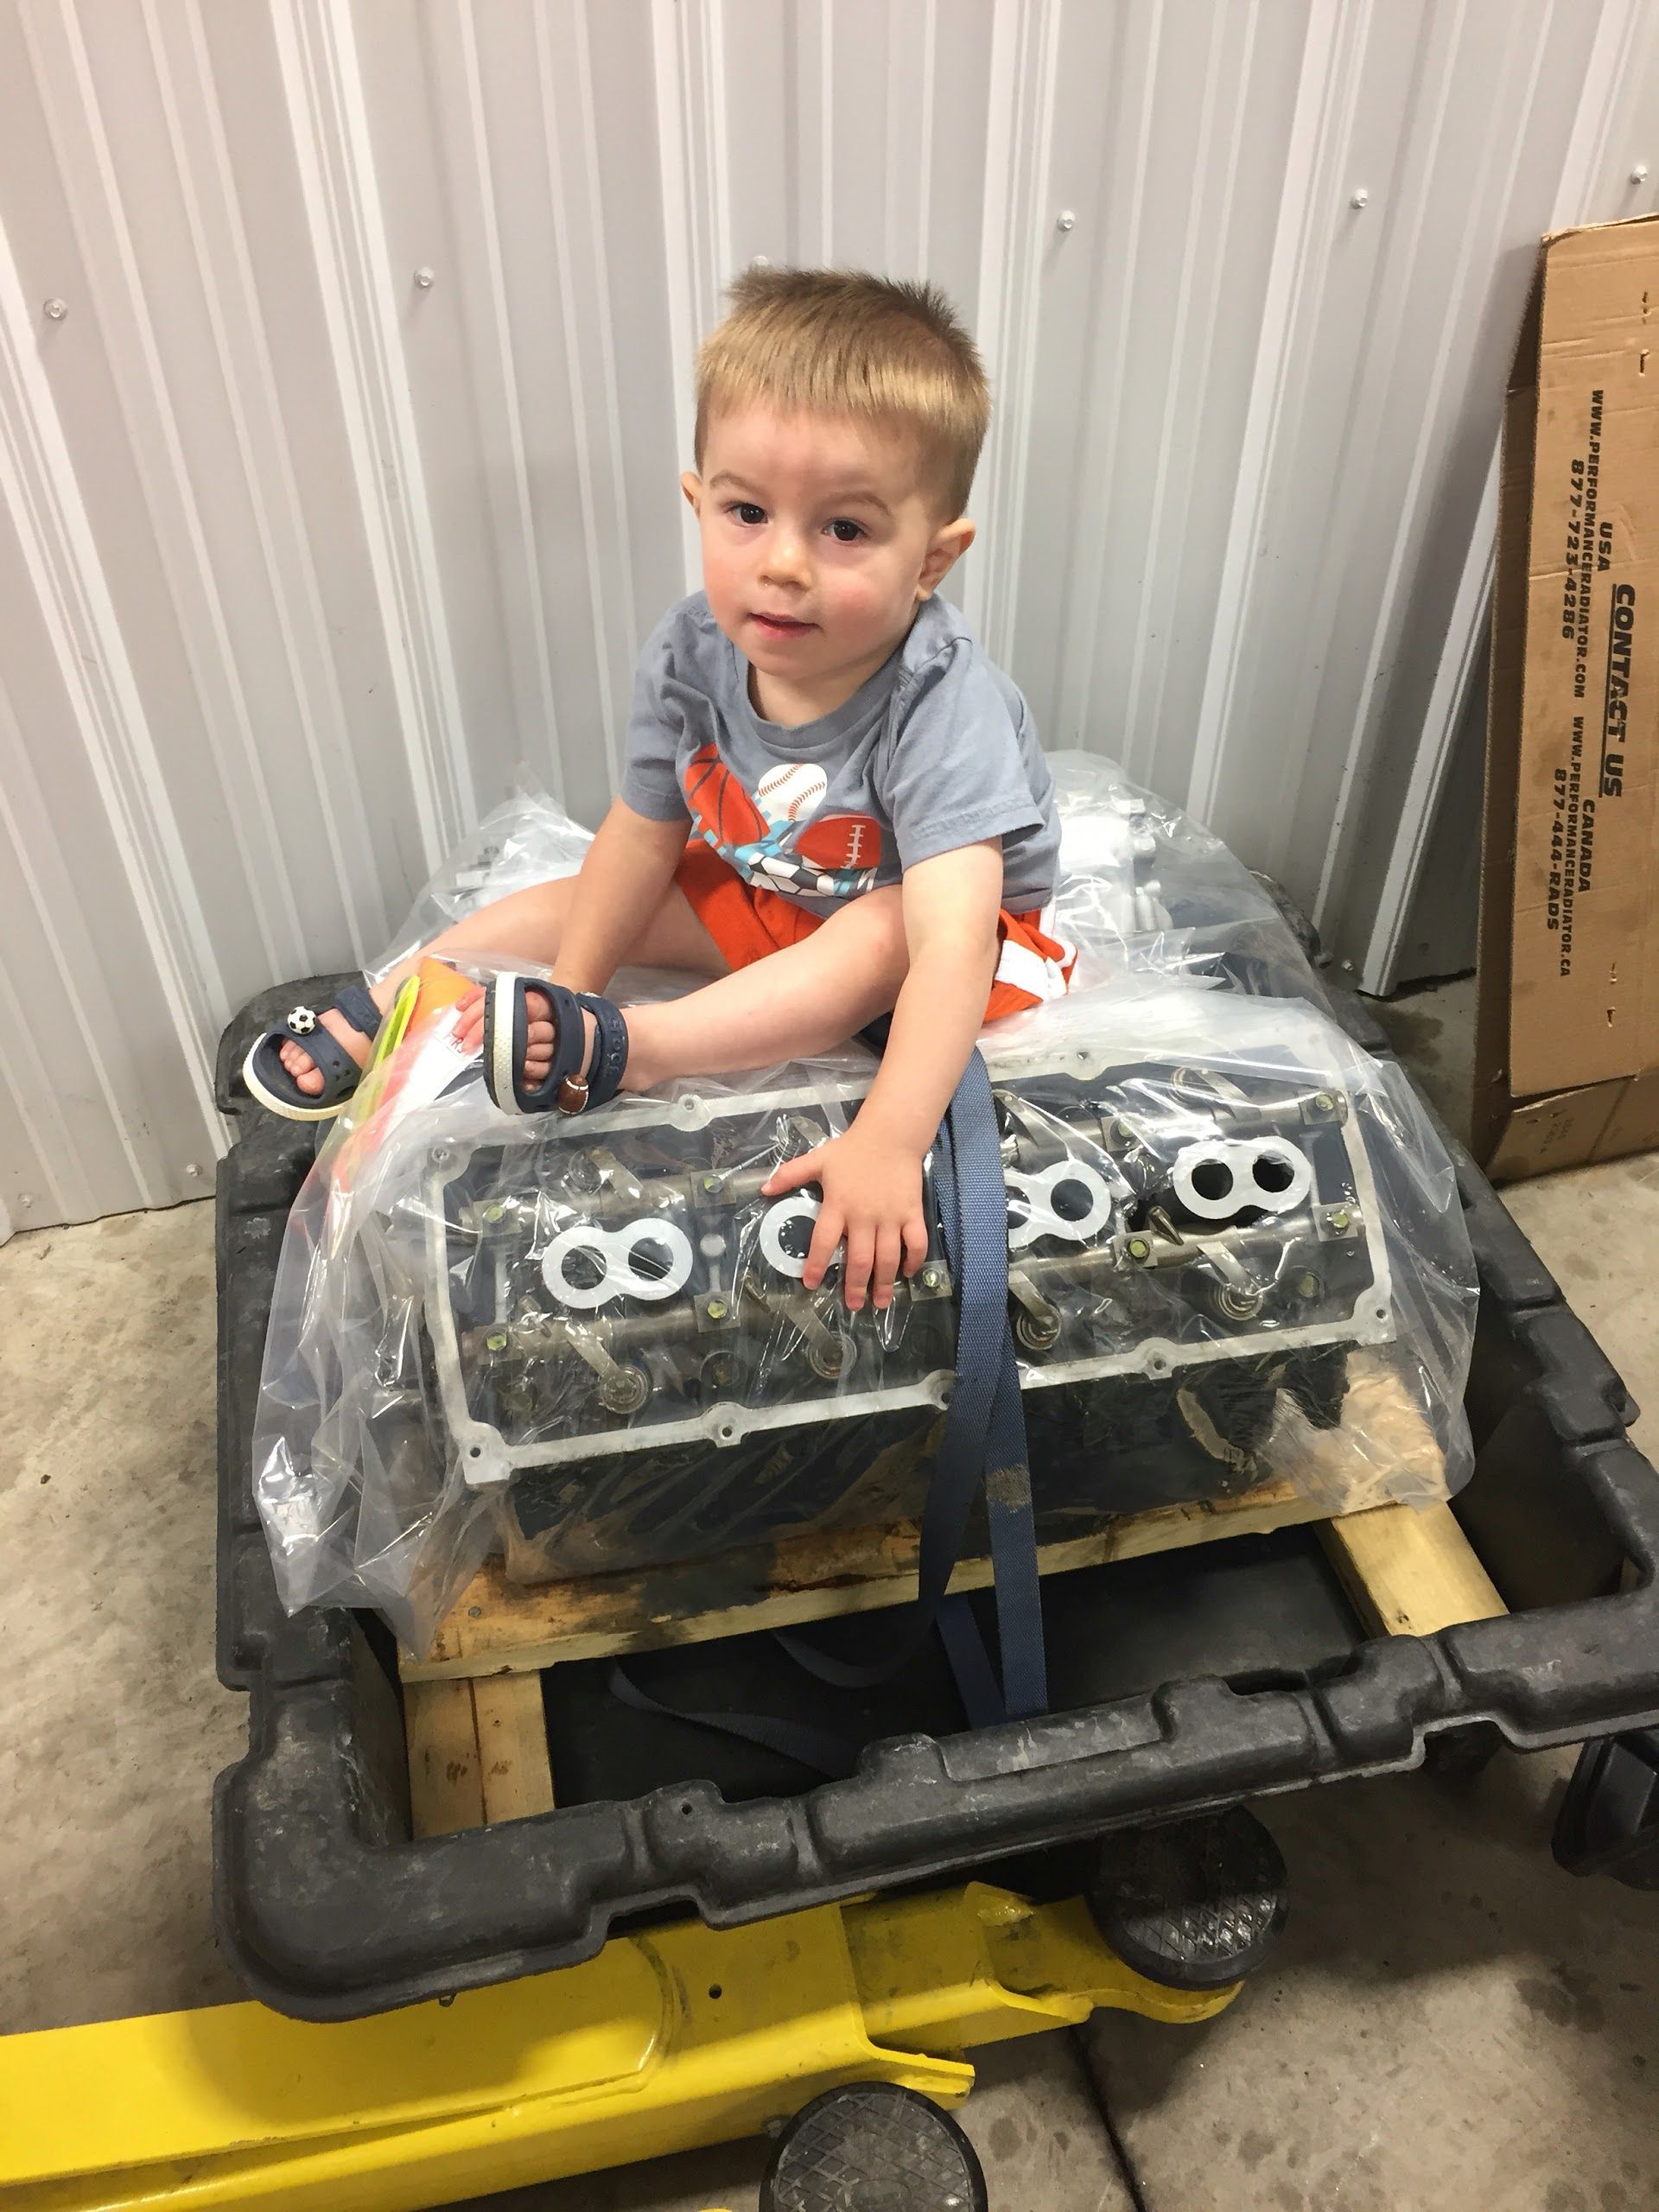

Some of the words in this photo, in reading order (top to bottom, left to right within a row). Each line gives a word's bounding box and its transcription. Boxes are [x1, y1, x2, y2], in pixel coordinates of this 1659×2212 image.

[1562, 459, 1585, 639] 877-723-4286
[1574, 390, 1604, 698] WWW.PERFORMANCERADIATOR.COM
[1597, 522, 1613, 571] USA
[1608, 583, 1636, 742] CONTACT
[1548, 768, 1567, 931] 877-444-RADS
[1560, 716, 1584, 977] WWW.PERFORMANCERADIATOR.CA
[1579, 799, 1595, 893] CANADA
[1604, 753, 1624, 798] US
